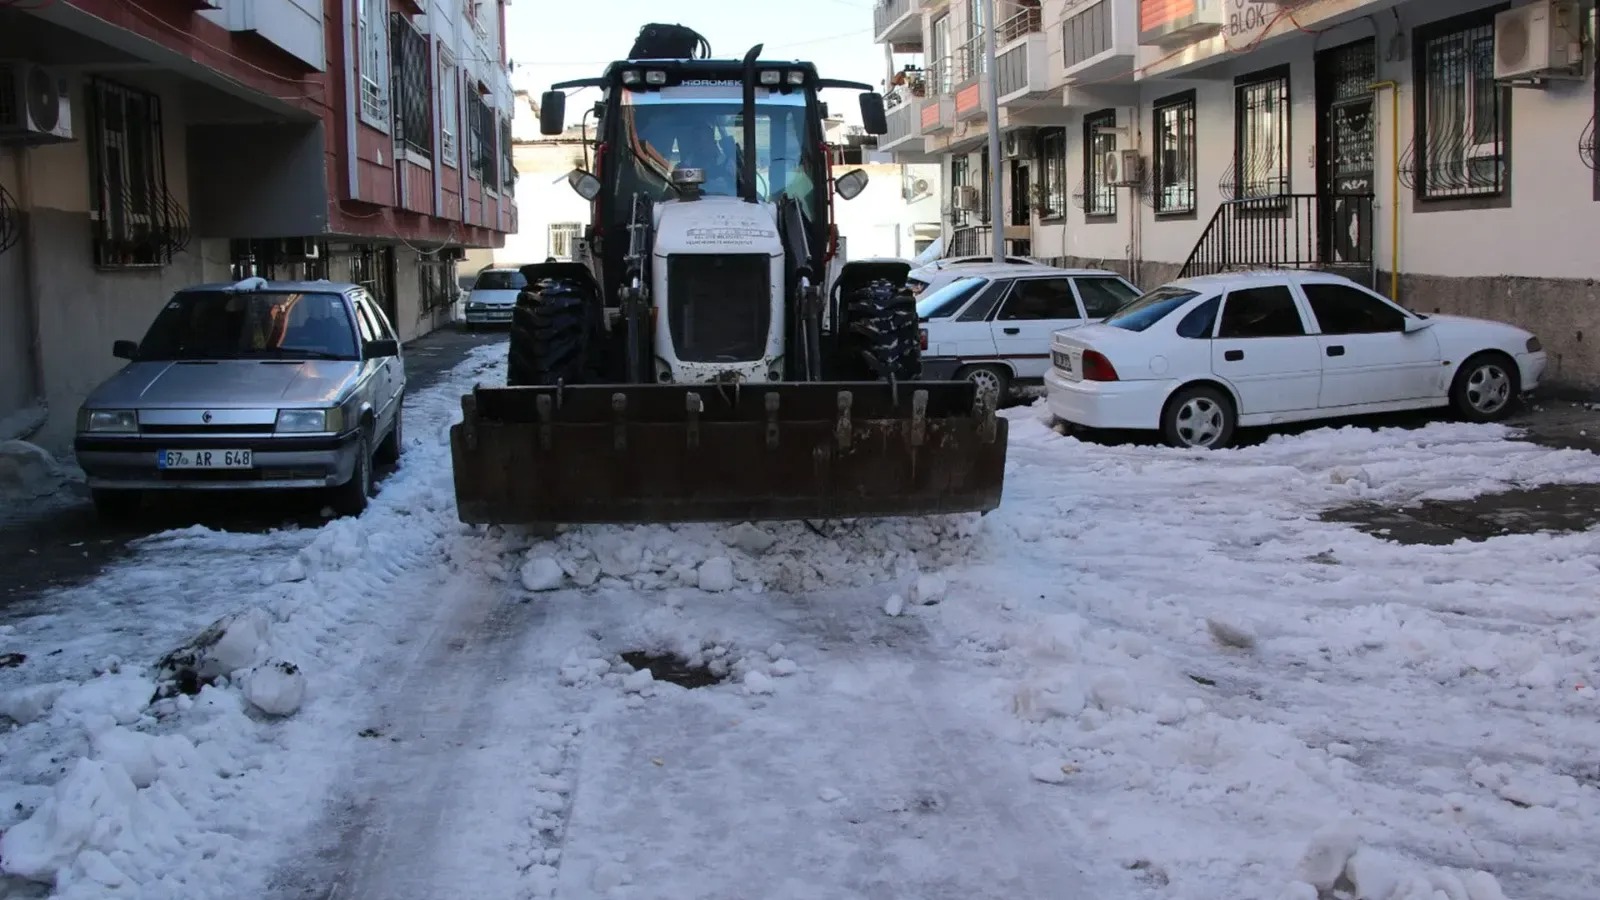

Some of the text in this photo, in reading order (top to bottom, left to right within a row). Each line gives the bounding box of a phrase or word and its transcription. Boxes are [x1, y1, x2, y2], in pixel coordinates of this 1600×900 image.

[1230, 3, 1265, 36] BLOK
[167, 450, 250, 466] 67 AR 648
